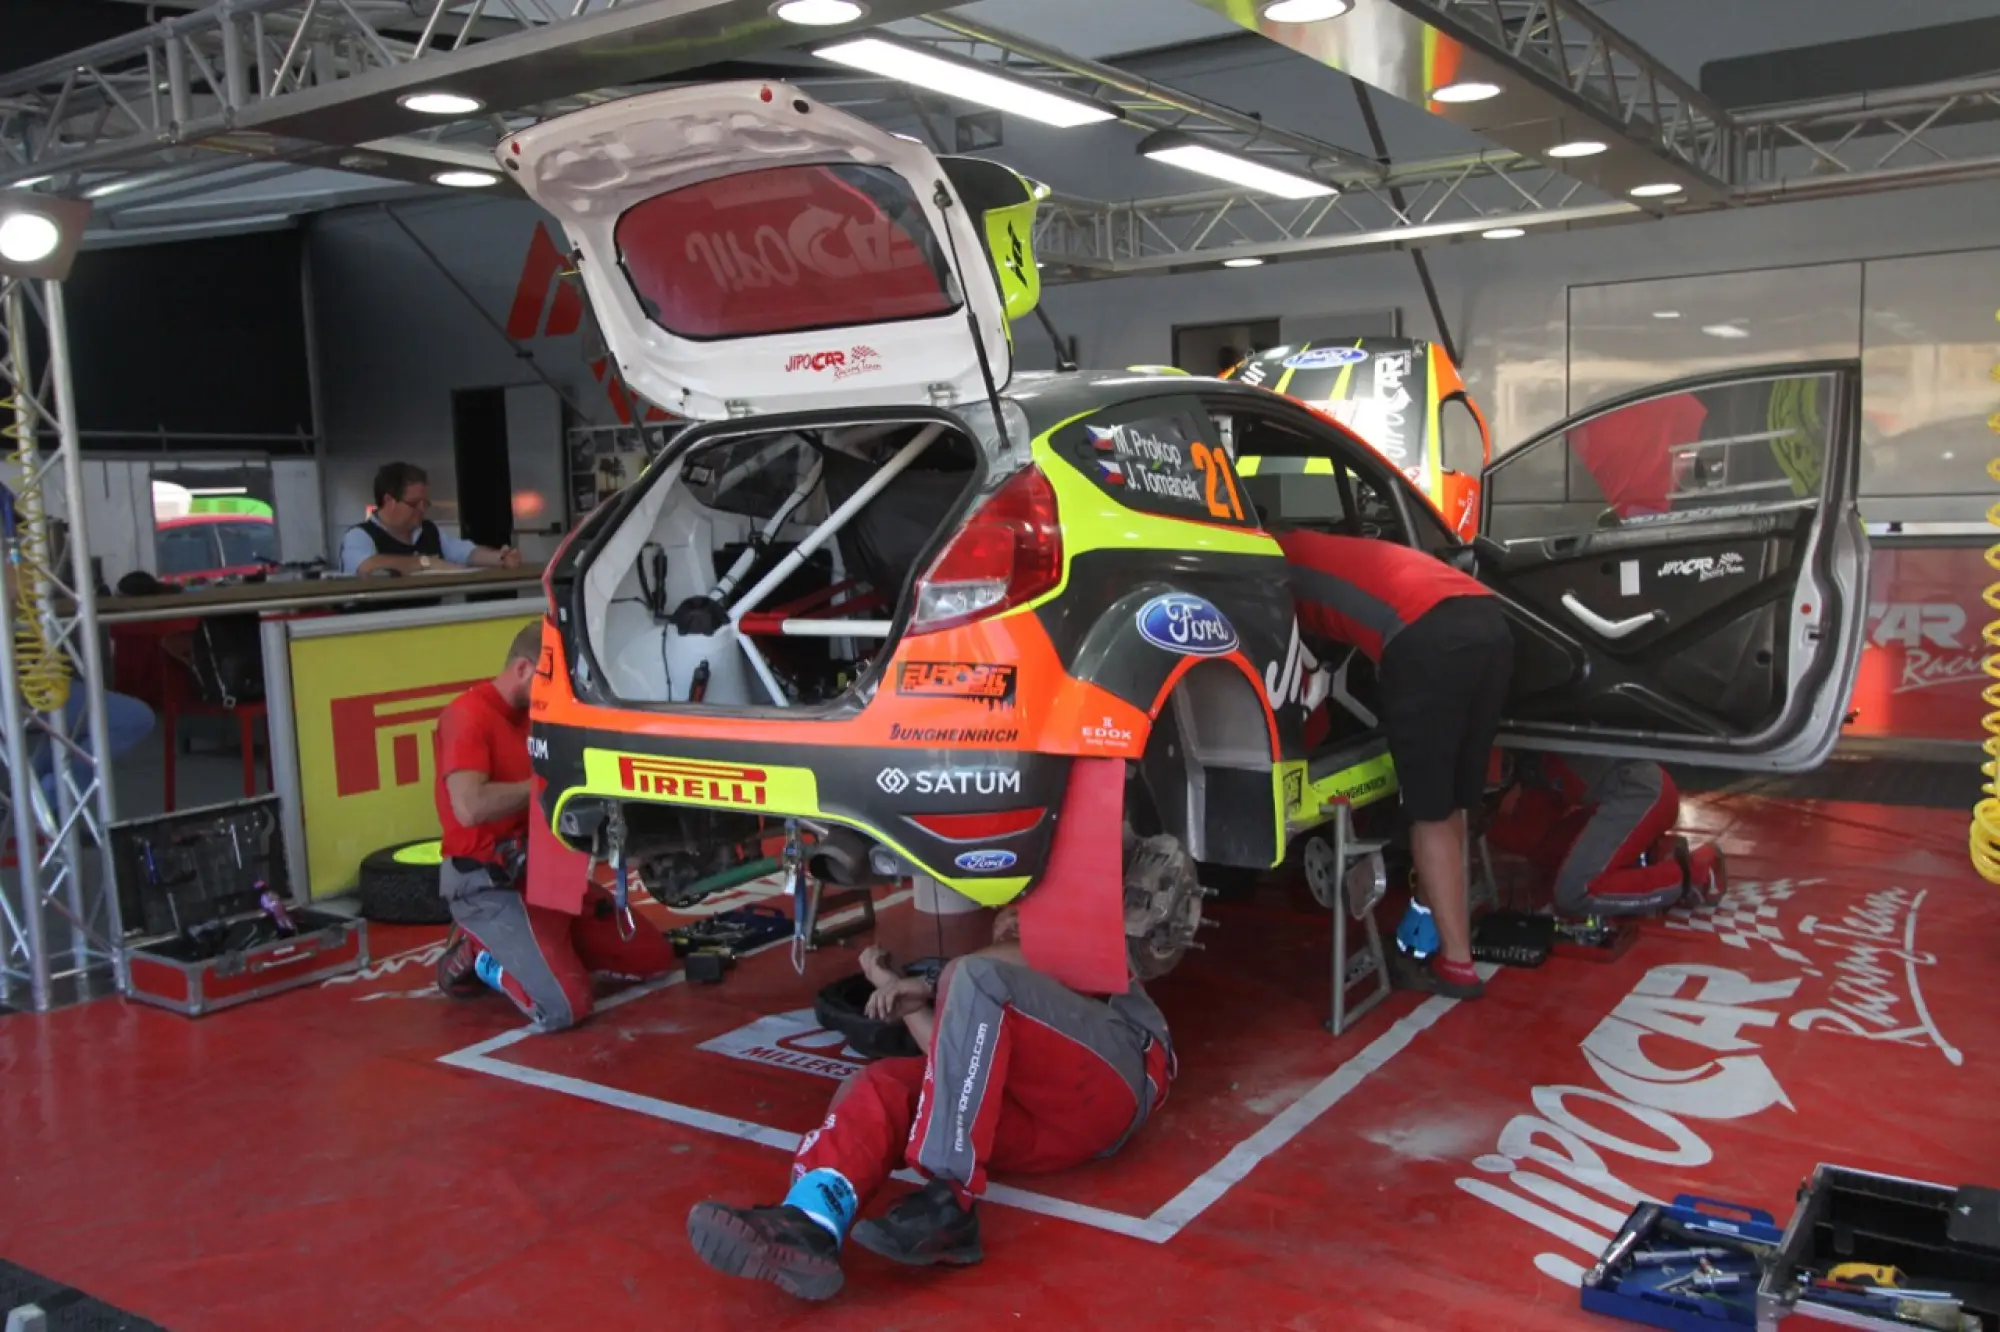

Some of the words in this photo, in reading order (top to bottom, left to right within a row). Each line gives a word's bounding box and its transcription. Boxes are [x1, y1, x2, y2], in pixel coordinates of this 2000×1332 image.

[1130, 428, 1182, 470] Prokop
[1125, 461, 1142, 491] J.
[1190, 440, 1245, 521] 21
[1164, 599, 1229, 643] Ford
[1081, 726, 1132, 740] EDOX
[618, 755, 767, 805] PIRELLI
[915, 771, 1021, 794] SATUM
[739, 1045, 862, 1078] MILLERS
